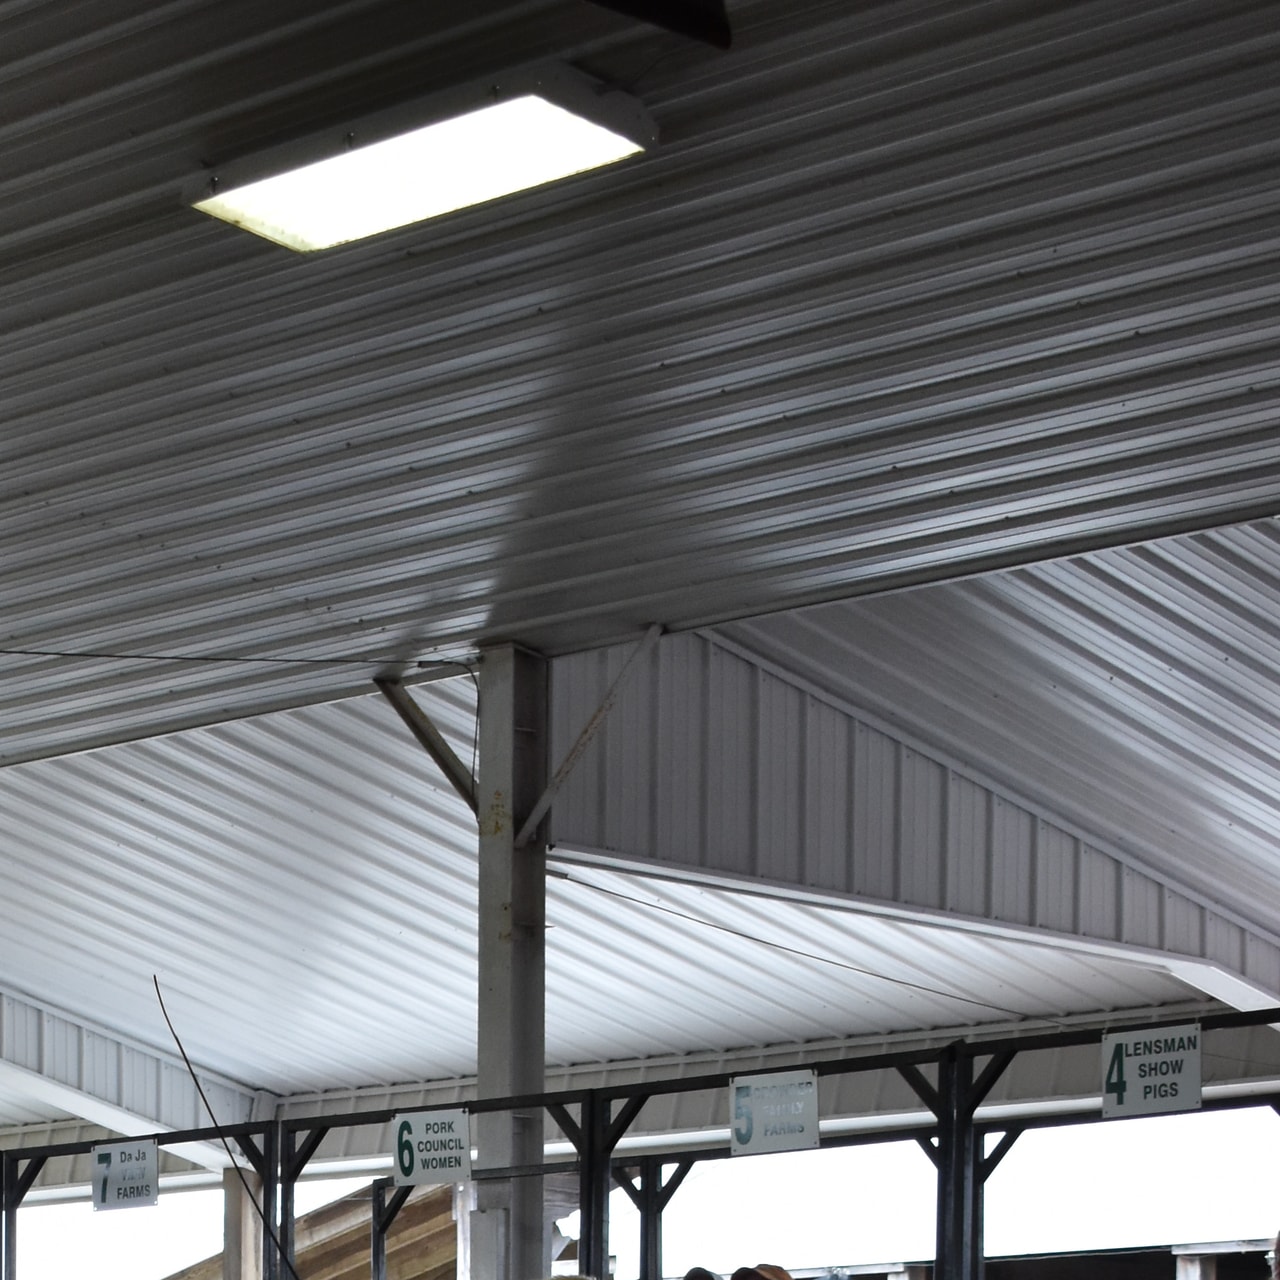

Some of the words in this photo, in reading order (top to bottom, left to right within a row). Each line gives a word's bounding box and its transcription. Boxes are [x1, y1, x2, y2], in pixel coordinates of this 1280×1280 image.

[1125, 1036, 1197, 1057] LENSMAN
[1105, 1043, 1127, 1105] 4
[1138, 1059, 1184, 1078] SHOW
[1143, 1082, 1178, 1100] PIGS
[735, 1085, 753, 1145] 5
[425, 1121, 455, 1135] PORK
[398, 1120, 415, 1178] 6
[417, 1138, 465, 1152] COUNCIL
[120, 1151, 132, 1163] Da
[135, 1149, 147, 1161] Ja
[421, 1156, 462, 1170] WOMEN
[97, 1152, 112, 1204] 7
[117, 1184, 151, 1199] FARMS
